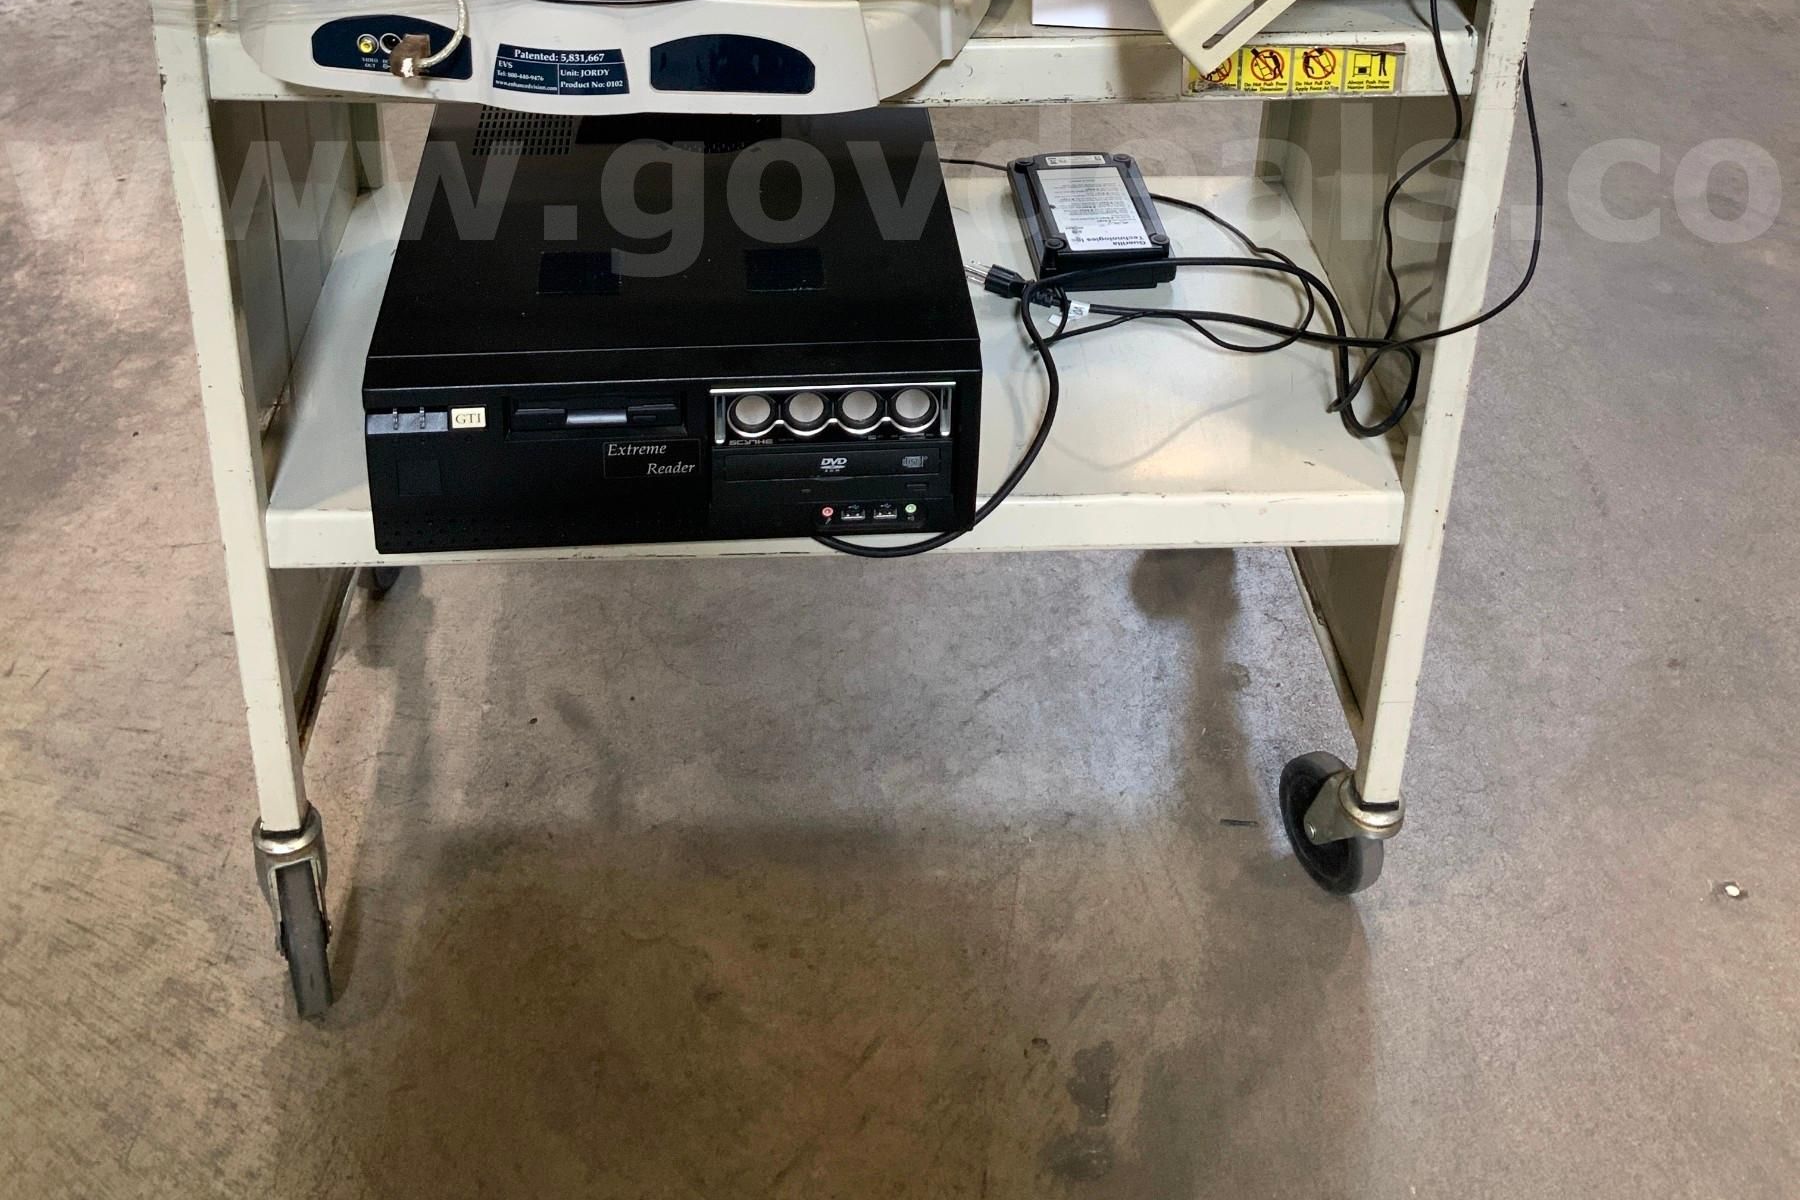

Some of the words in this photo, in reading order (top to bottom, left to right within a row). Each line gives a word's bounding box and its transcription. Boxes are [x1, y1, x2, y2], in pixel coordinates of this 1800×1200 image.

[514, 49, 559, 62] Patented:
[560, 53, 605, 64] 5,831,667
[498, 60, 513, 68] EVS
[560, 69, 579, 77] Unit:
[581, 69, 610, 77] JORDY
[560, 80, 588, 88] Product
[606, 80, 623, 88] 0102
[456, 413, 482, 425] GTI
[607, 443, 667, 456] Extreme
[821, 457, 848, 466] DVD
[647, 462, 695, 475] Reader
